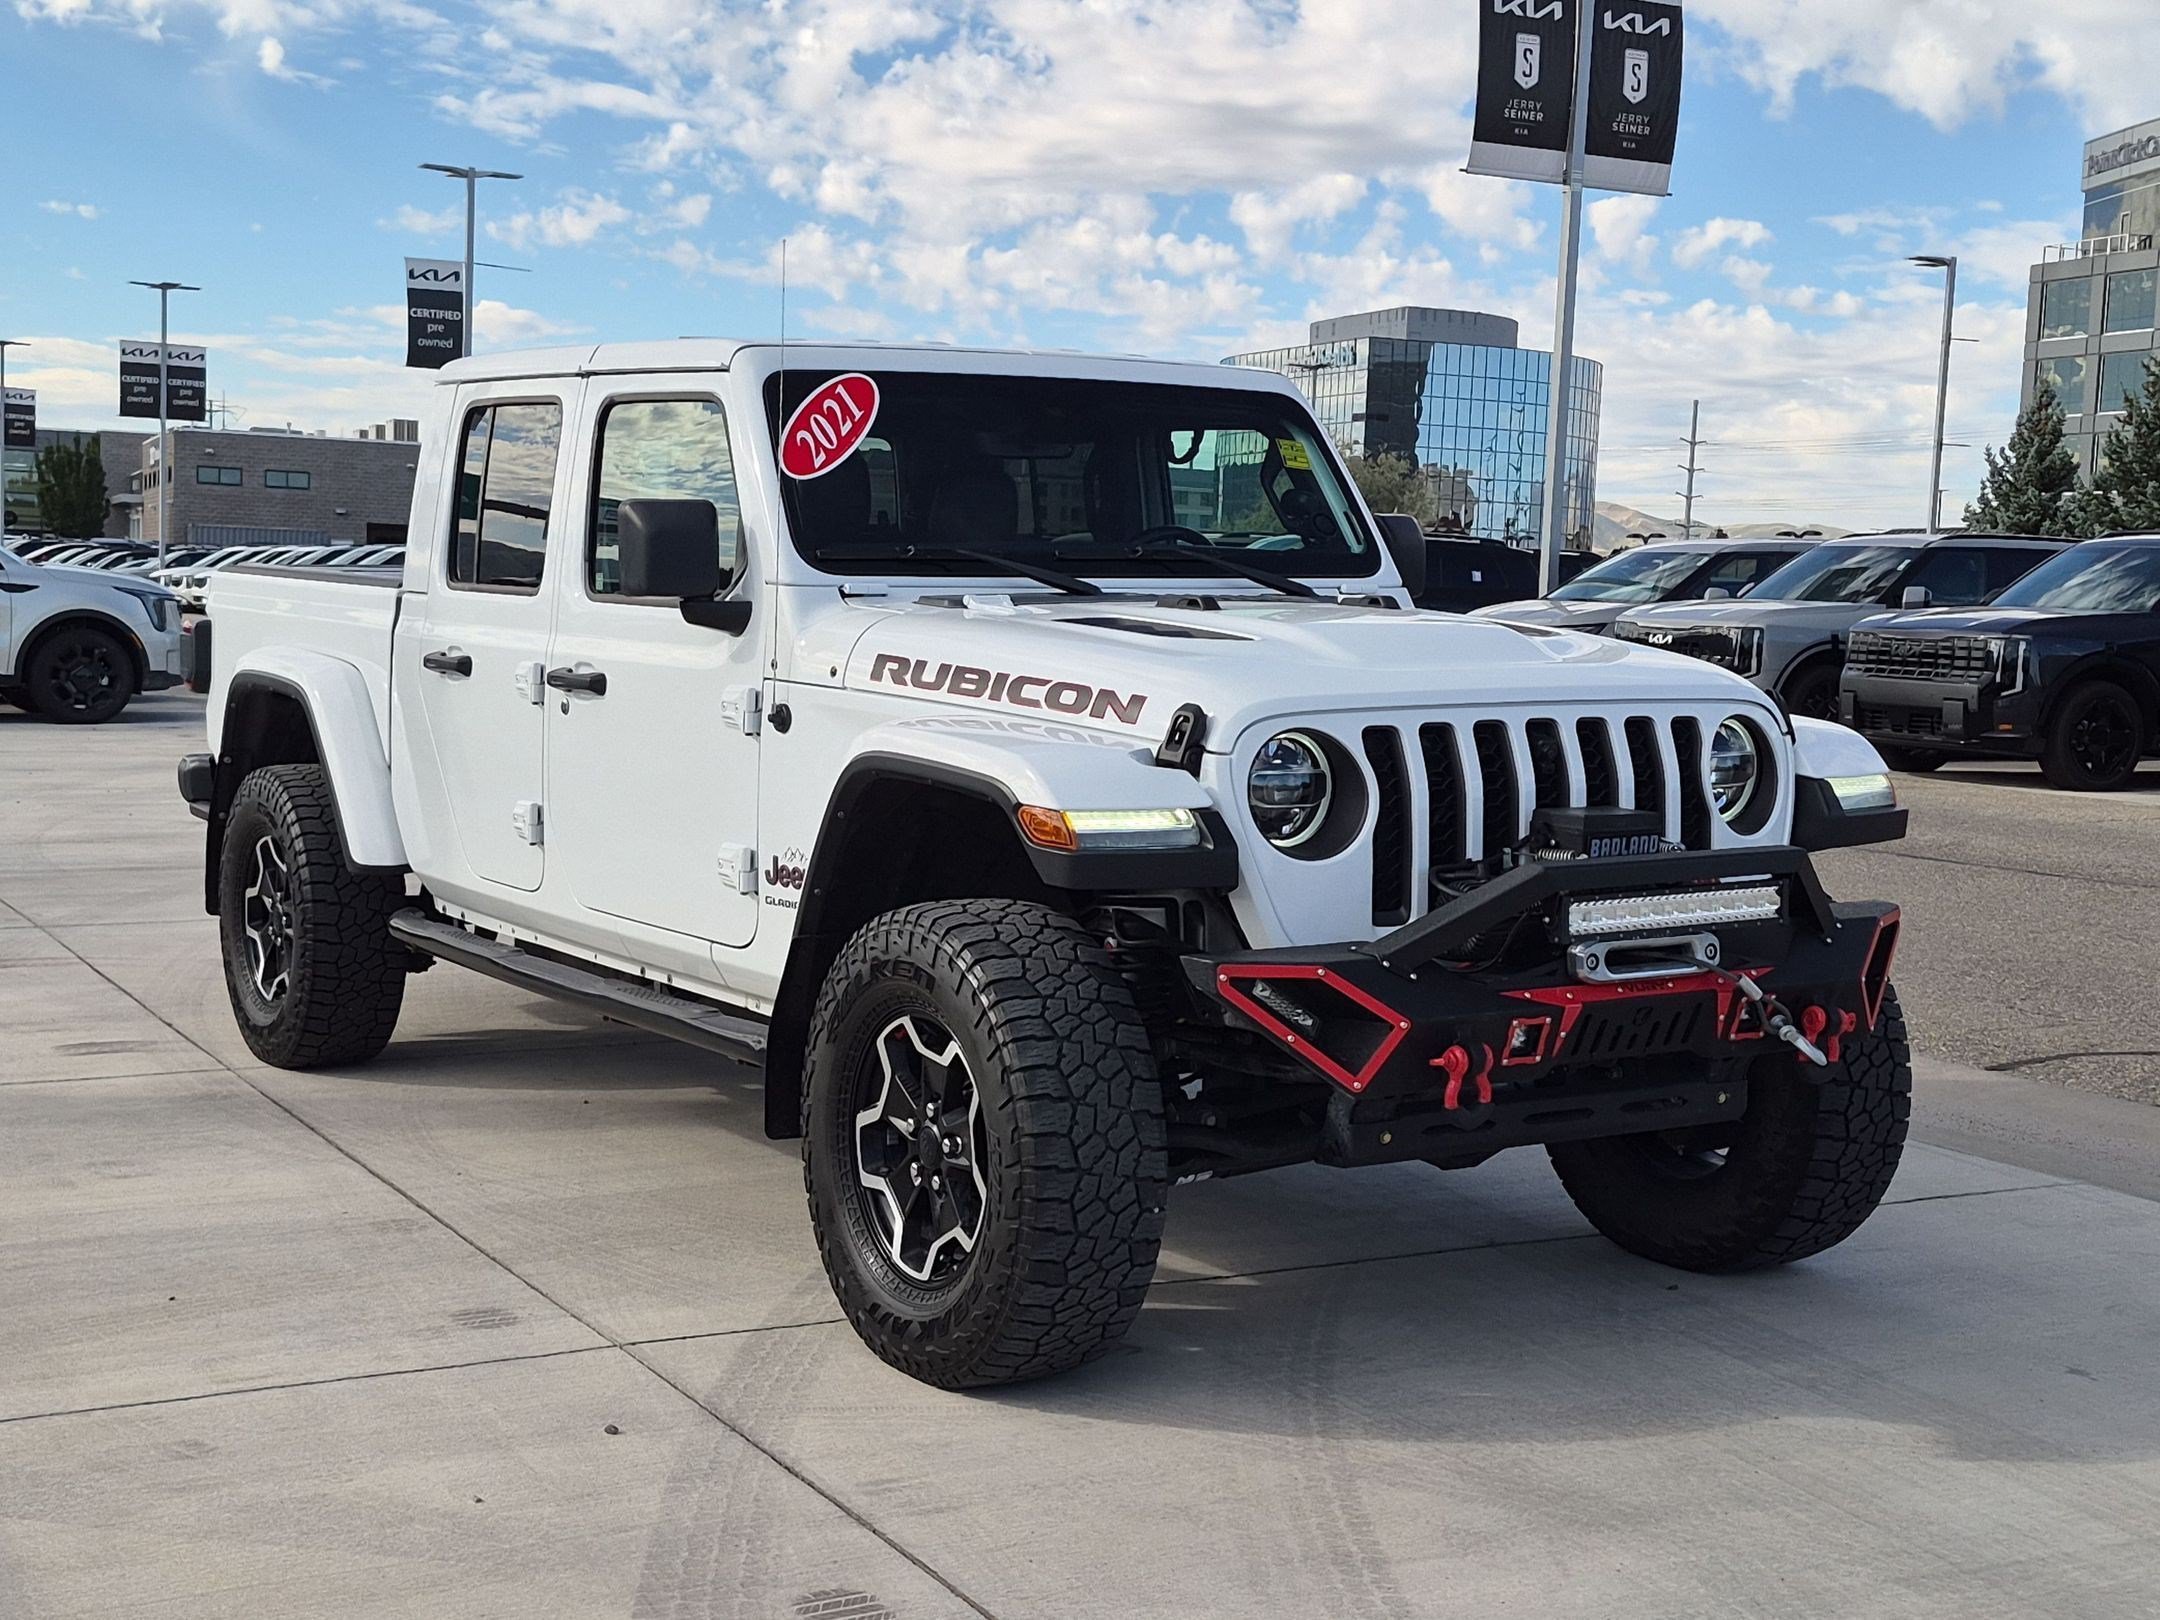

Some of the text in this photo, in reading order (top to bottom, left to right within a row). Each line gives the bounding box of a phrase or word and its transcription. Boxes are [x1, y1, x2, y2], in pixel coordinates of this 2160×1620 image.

[1603, 9, 1670, 37] KIA
[1507, 99, 1542, 111] JERRY
[1504, 108, 1544, 122] SEINER
[1616, 112, 1650, 124] JERRY
[1612, 122, 1651, 135] SEINER
[409, 268, 460, 282] KIA
[410, 307, 461, 321] CERTIFIED
[427, 323, 445, 333] pre
[418, 337, 453, 349] owned
[122, 347, 159, 357] KIA
[168, 351, 205, 361] KIA
[122, 375, 159, 384] CERTIFIED
[168, 378, 205, 388] CERTIFIED
[796, 384, 865, 470] 2021
[1649, 633, 1673, 645] KIA
[869, 653, 1148, 725] RUBICON
[1590, 835, 1660, 858] BADLAND
[765, 855, 806, 890] Jee
